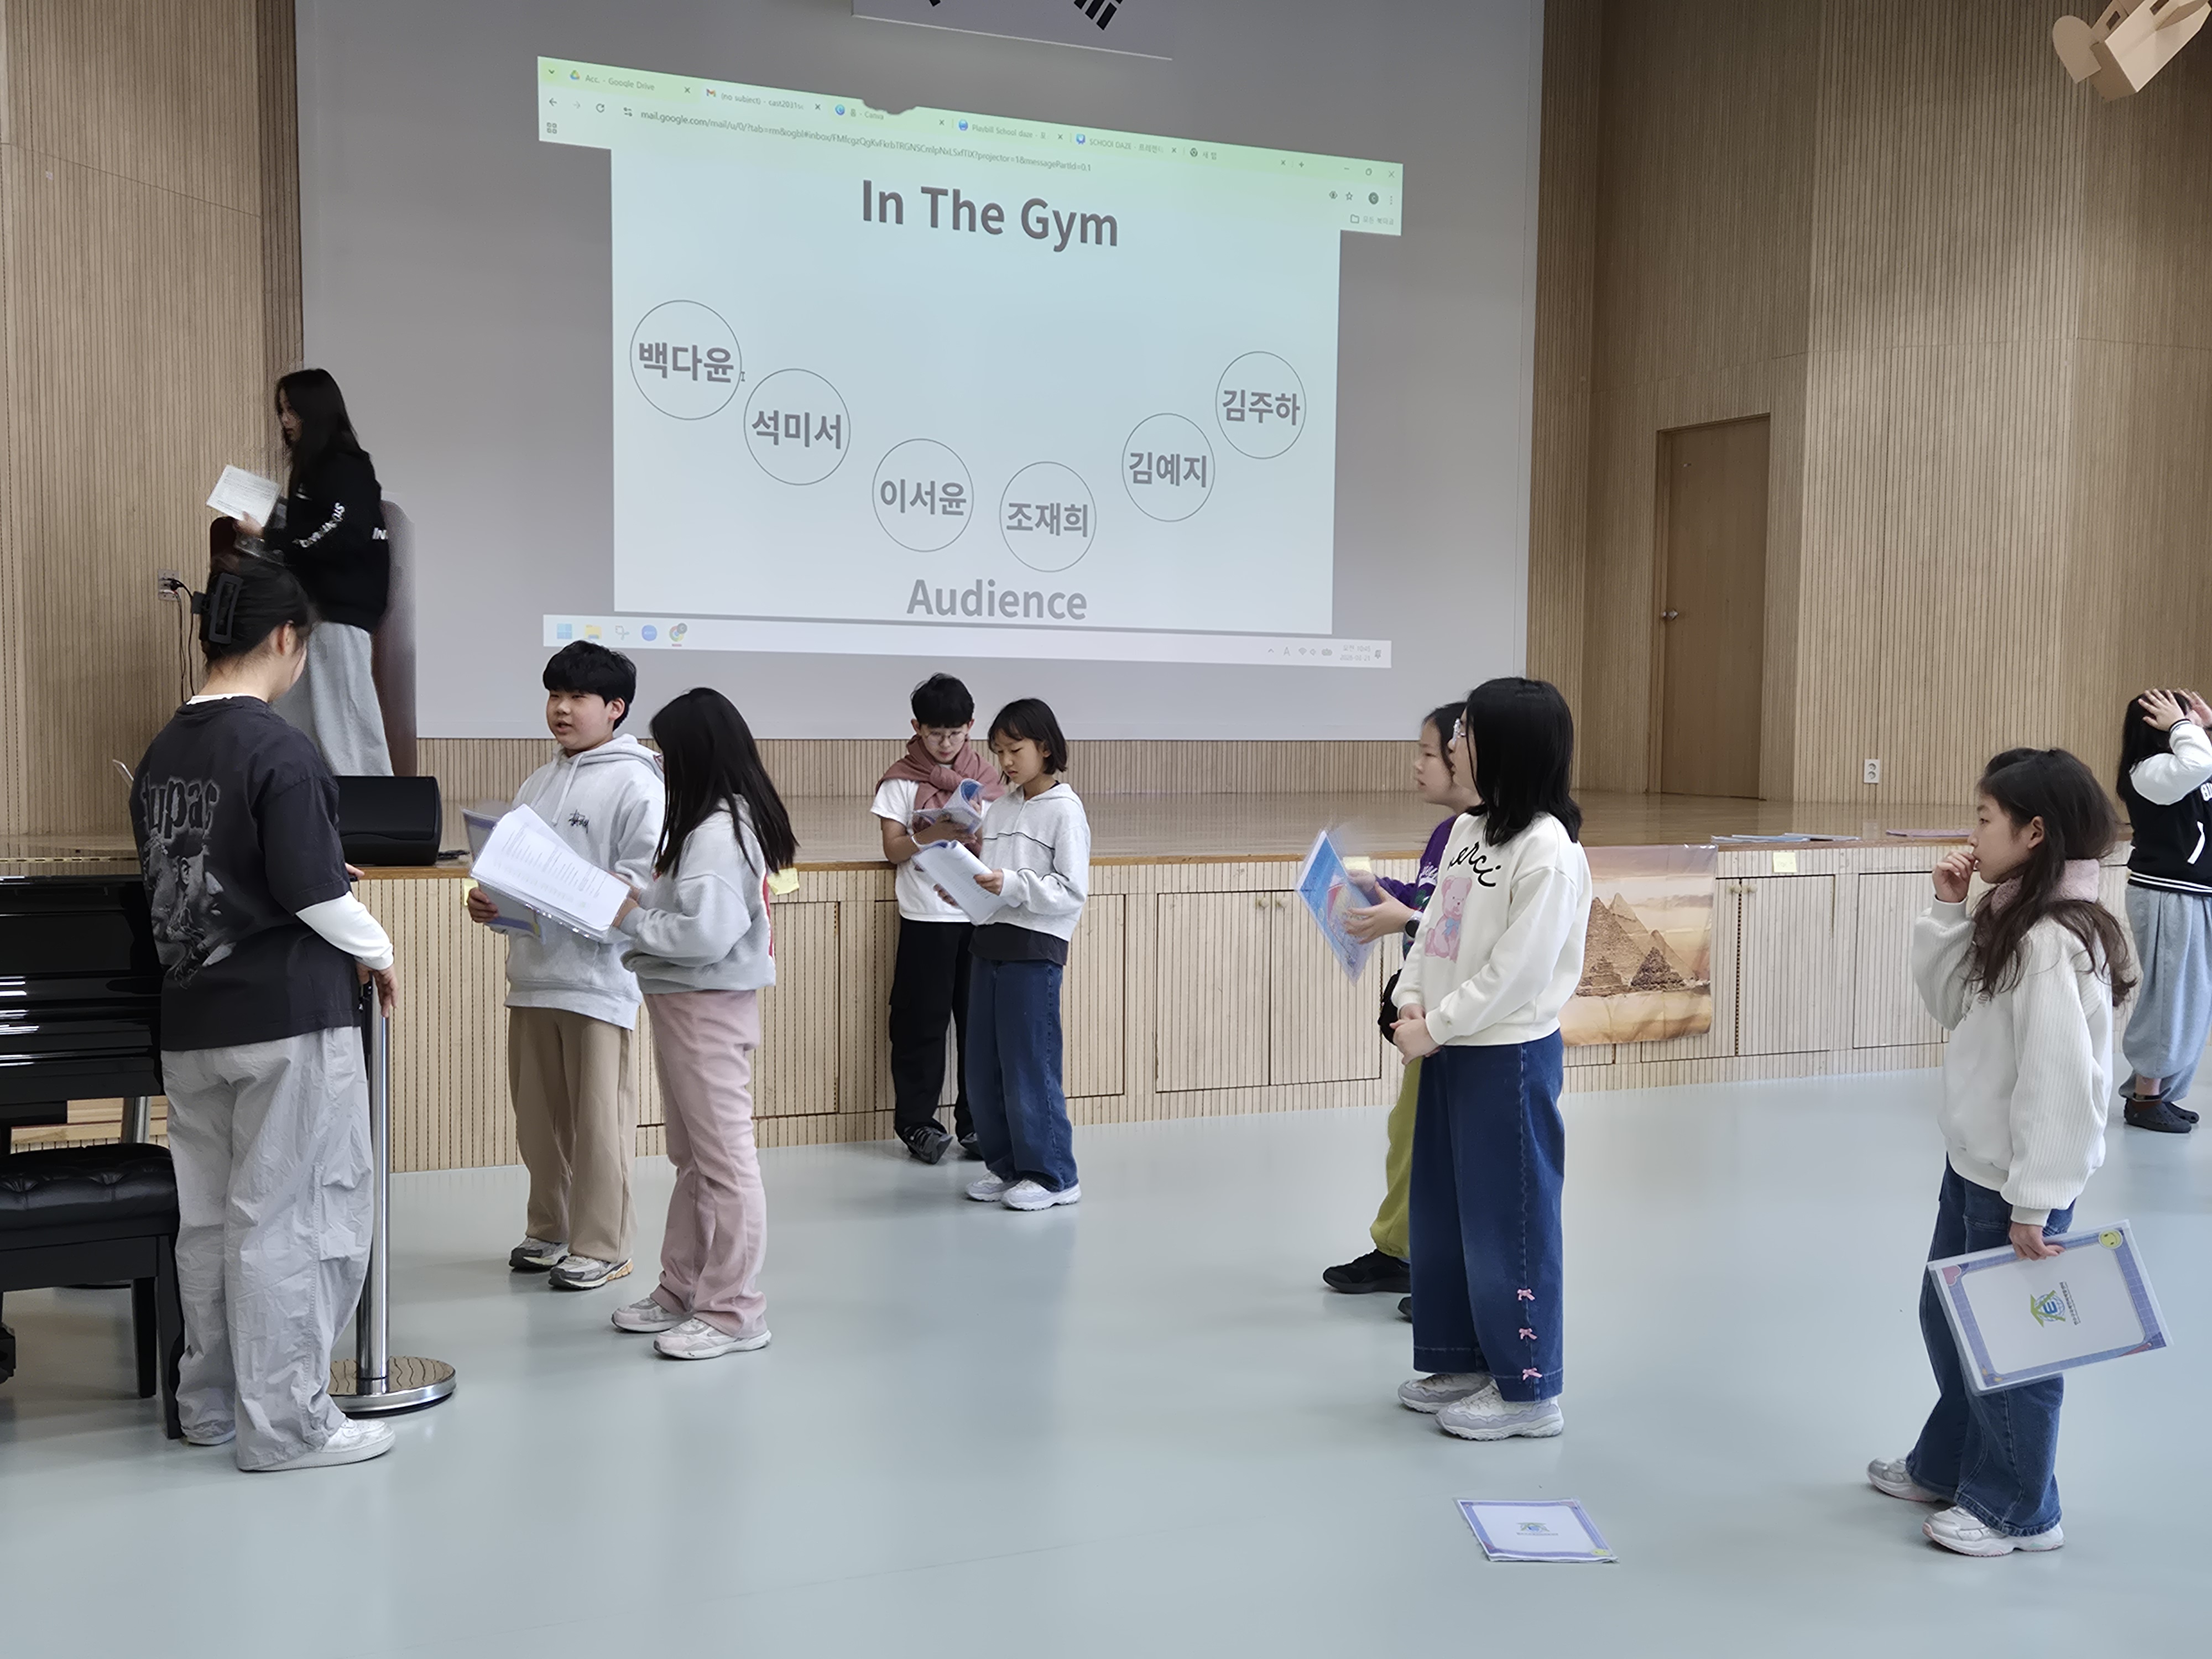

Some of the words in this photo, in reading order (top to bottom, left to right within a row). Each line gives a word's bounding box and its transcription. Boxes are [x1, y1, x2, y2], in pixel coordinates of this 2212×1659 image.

[608, 77, 634, 88] Google
[636, 81, 655, 91] Drive
[721, 92, 733, 101] (no
[735, 95, 761, 106] subject)
[864, 111, 884, 120] Canva
[972, 124, 994, 134] Playbill
[996, 127, 1016, 136] School
[1019, 128, 1032, 138] daze
[1089, 139, 1114, 148] SCHOOL
[1115, 141, 1131, 150] DAZE
[863, 180, 904, 225] In
[921, 186, 1004, 235] The
[1021, 197, 1117, 252] Gym
[639, 342, 734, 383] 백다윤
[1222, 389, 1300, 425] 김주하
[752, 410, 841, 450] 석미서
[1129, 452, 1207, 488] 김예지
[880, 479, 967, 516] 이서윤
[1006, 502, 1088, 538] 조재희
[906, 579, 1087, 620] Audience
[1447, 842, 1501, 887] erci
